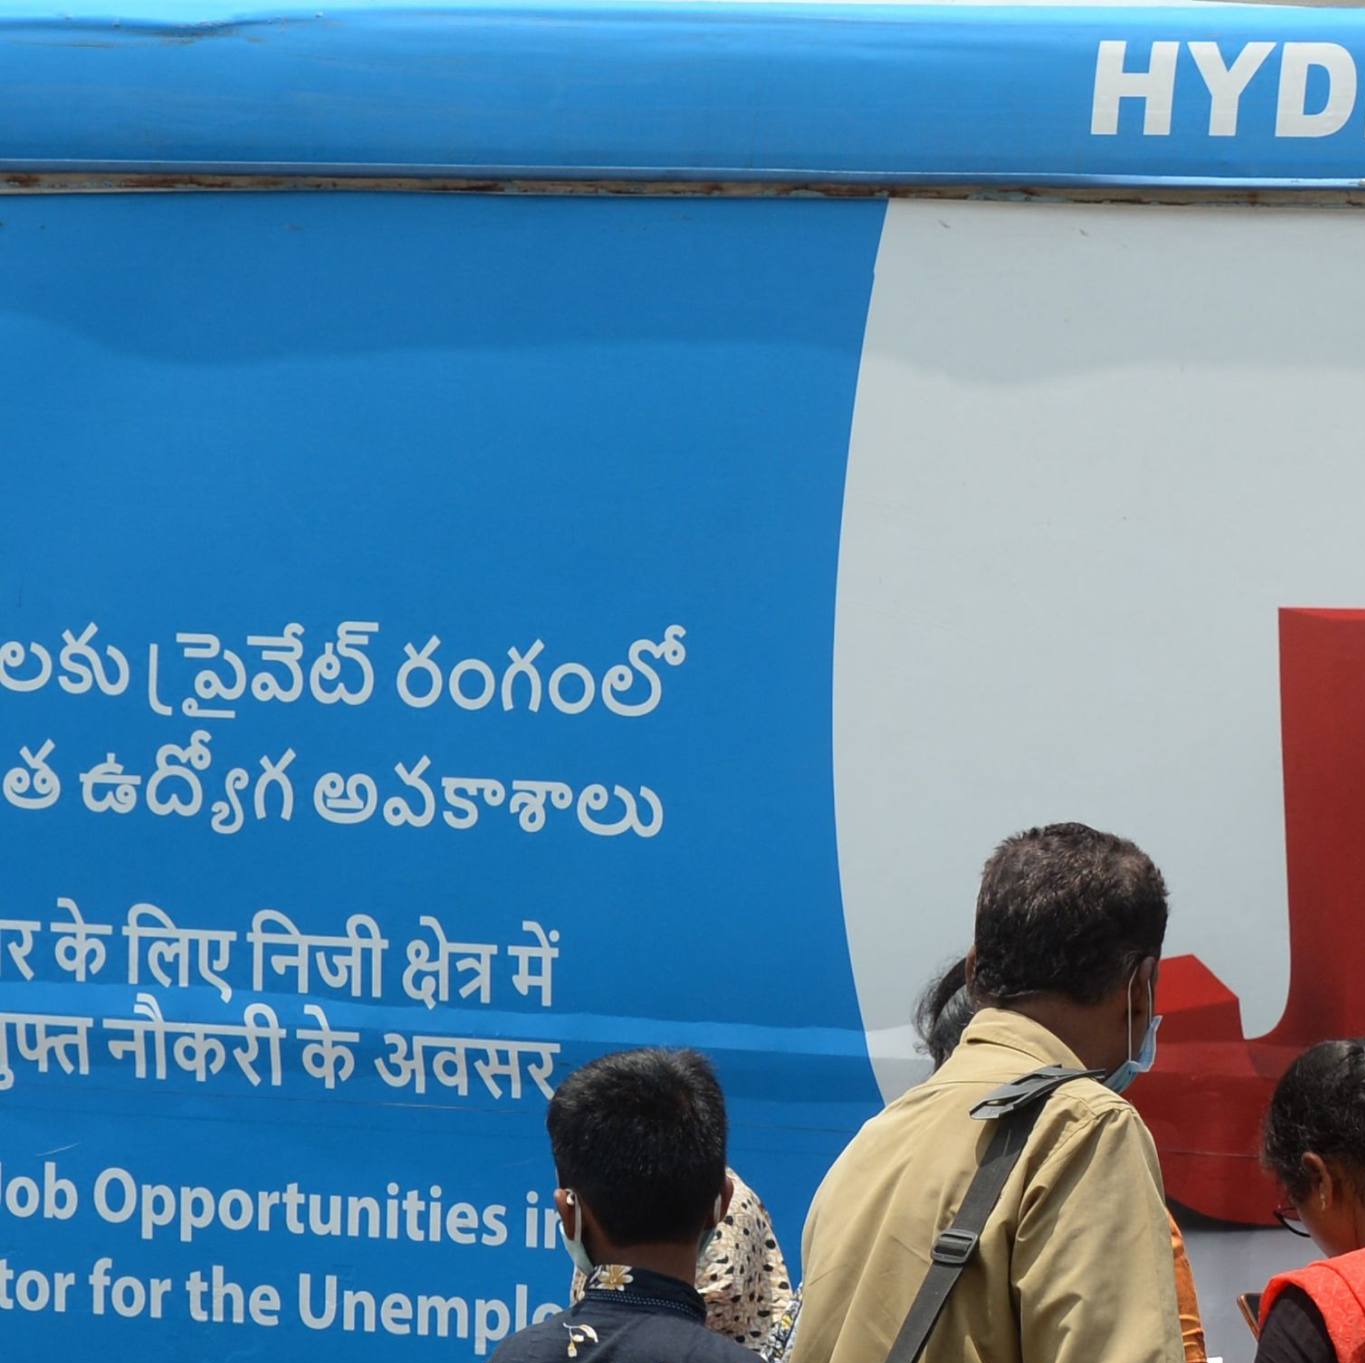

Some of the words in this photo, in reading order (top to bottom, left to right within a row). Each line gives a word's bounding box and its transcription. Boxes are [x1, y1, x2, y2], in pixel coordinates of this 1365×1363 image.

[148, 620, 379, 719] ప్రైవేట్
[396, 624, 687, 717] రంగంలో
[80, 729, 297, 835] ఉద్యోగ
[313, 755, 664, 838] అవకాశాలు
[50, 897, 113, 983] के
[122, 903, 237, 1004] लिए
[246, 908, 389, 998] निजी
[402, 915, 498, 1010] क्षेत्र
[507, 920, 560, 1007] में
[103, 993, 287, 1087] नौकरी
[296, 1004, 360, 1089] के
[374, 1033, 561, 1101] अवसर
[0, 1161, 78, 1221] ob
[93, 1167, 508, 1247] Opportunities
[89, 1257, 172, 1319] for
[185, 1265, 281, 1327] the
